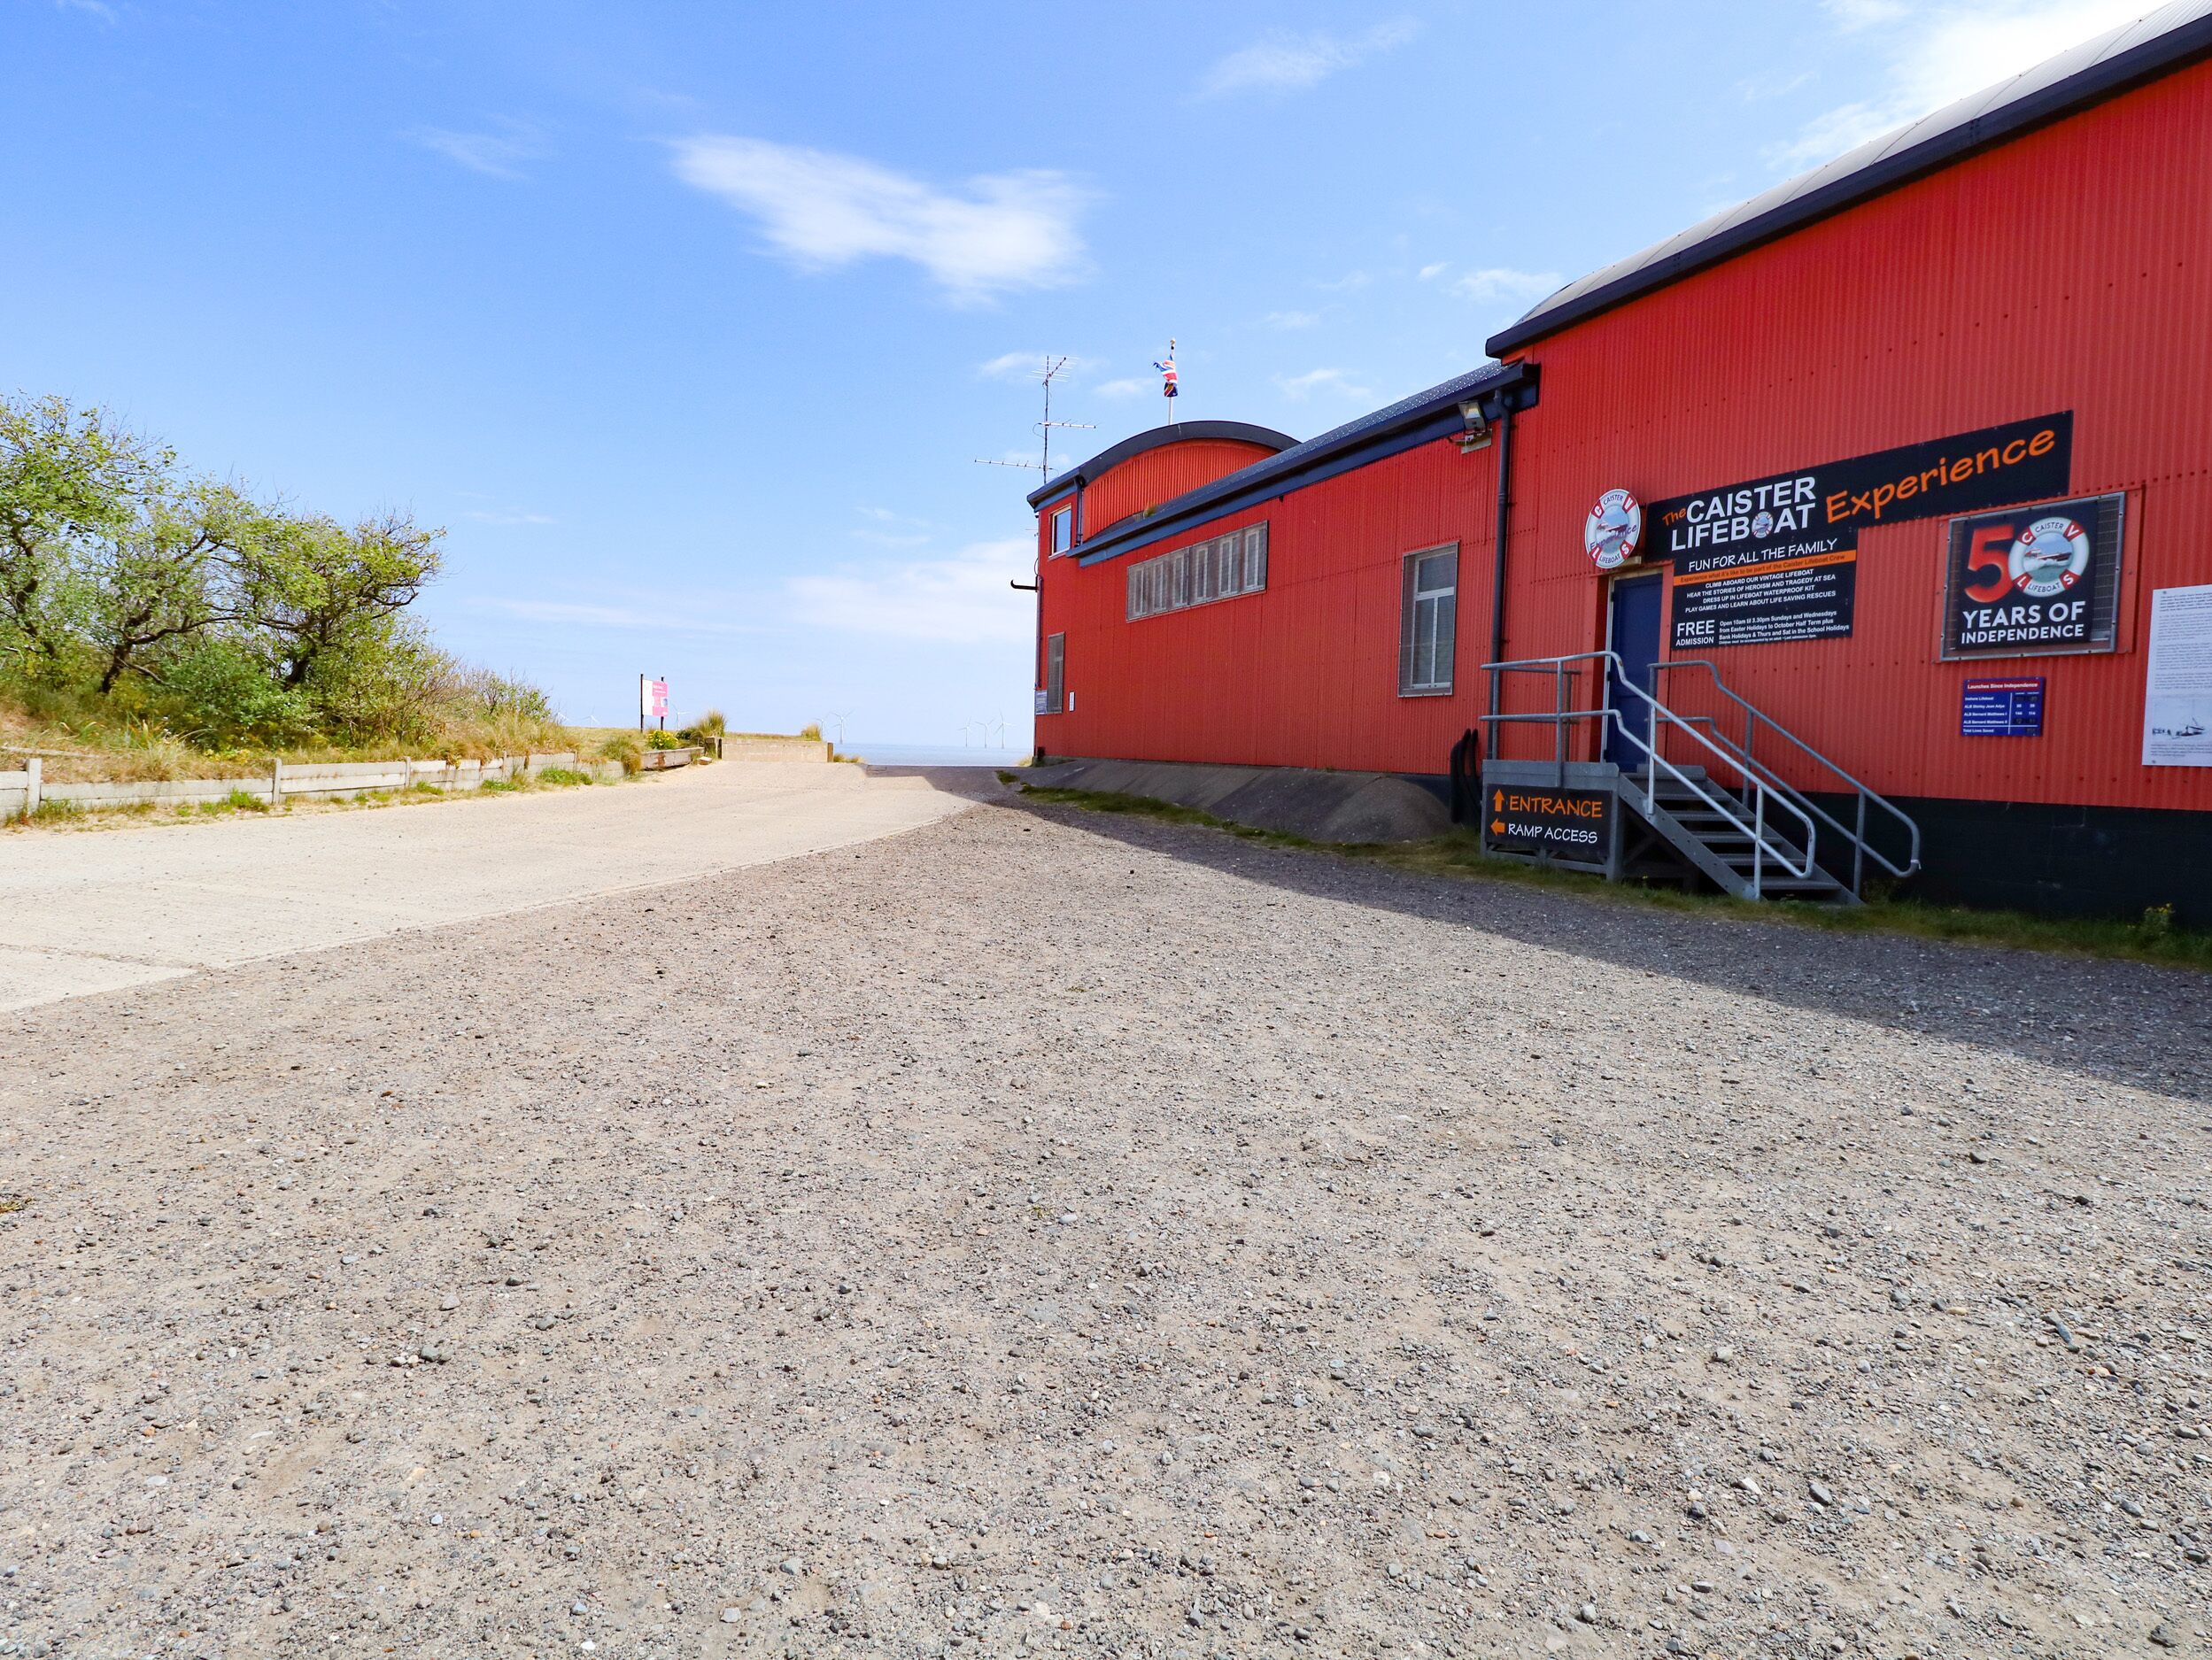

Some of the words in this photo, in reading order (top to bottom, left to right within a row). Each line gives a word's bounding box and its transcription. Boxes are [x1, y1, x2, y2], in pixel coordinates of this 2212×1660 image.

[1826, 429, 2055, 523] Experience
[1604, 494, 1623, 505] CAISTER
[1626, 497, 1633, 510] V
[1662, 507, 1686, 526] The
[1686, 476, 1816, 523] CAISTER
[2035, 521, 2064, 533] CAISTER
[2069, 525, 2079, 536] V
[2022, 533, 2032, 543] C
[1621, 544, 1629, 554] S
[1599, 553, 1620, 563] LIFEBOAT
[1689, 559, 1711, 572] FUN
[1713, 555, 1736, 567] FOR
[1737, 551, 1759, 564] ALL
[1761, 546, 1785, 560] THE
[1789, 538, 1837, 557] FAMILY
[1681, 574, 1707, 583] Experience
[2016, 576, 2027, 587] L
[2063, 574, 2074, 585] S
[1764, 586, 1804, 596] WATERPROOF
[2028, 583, 2061, 593] LIFEBOAT
[1962, 605, 2040, 629] YEARS
[2049, 600, 2085, 622] OF
[1677, 620, 1714, 637] FREE
[1961, 624, 2084, 644] INDEPENDENCE
[1676, 637, 1713, 646] ADMISSION
[1509, 795, 1602, 818] ENTRANCE
[1508, 823, 1543, 838] RAMP
[1544, 827, 1597, 844] ACCESS
